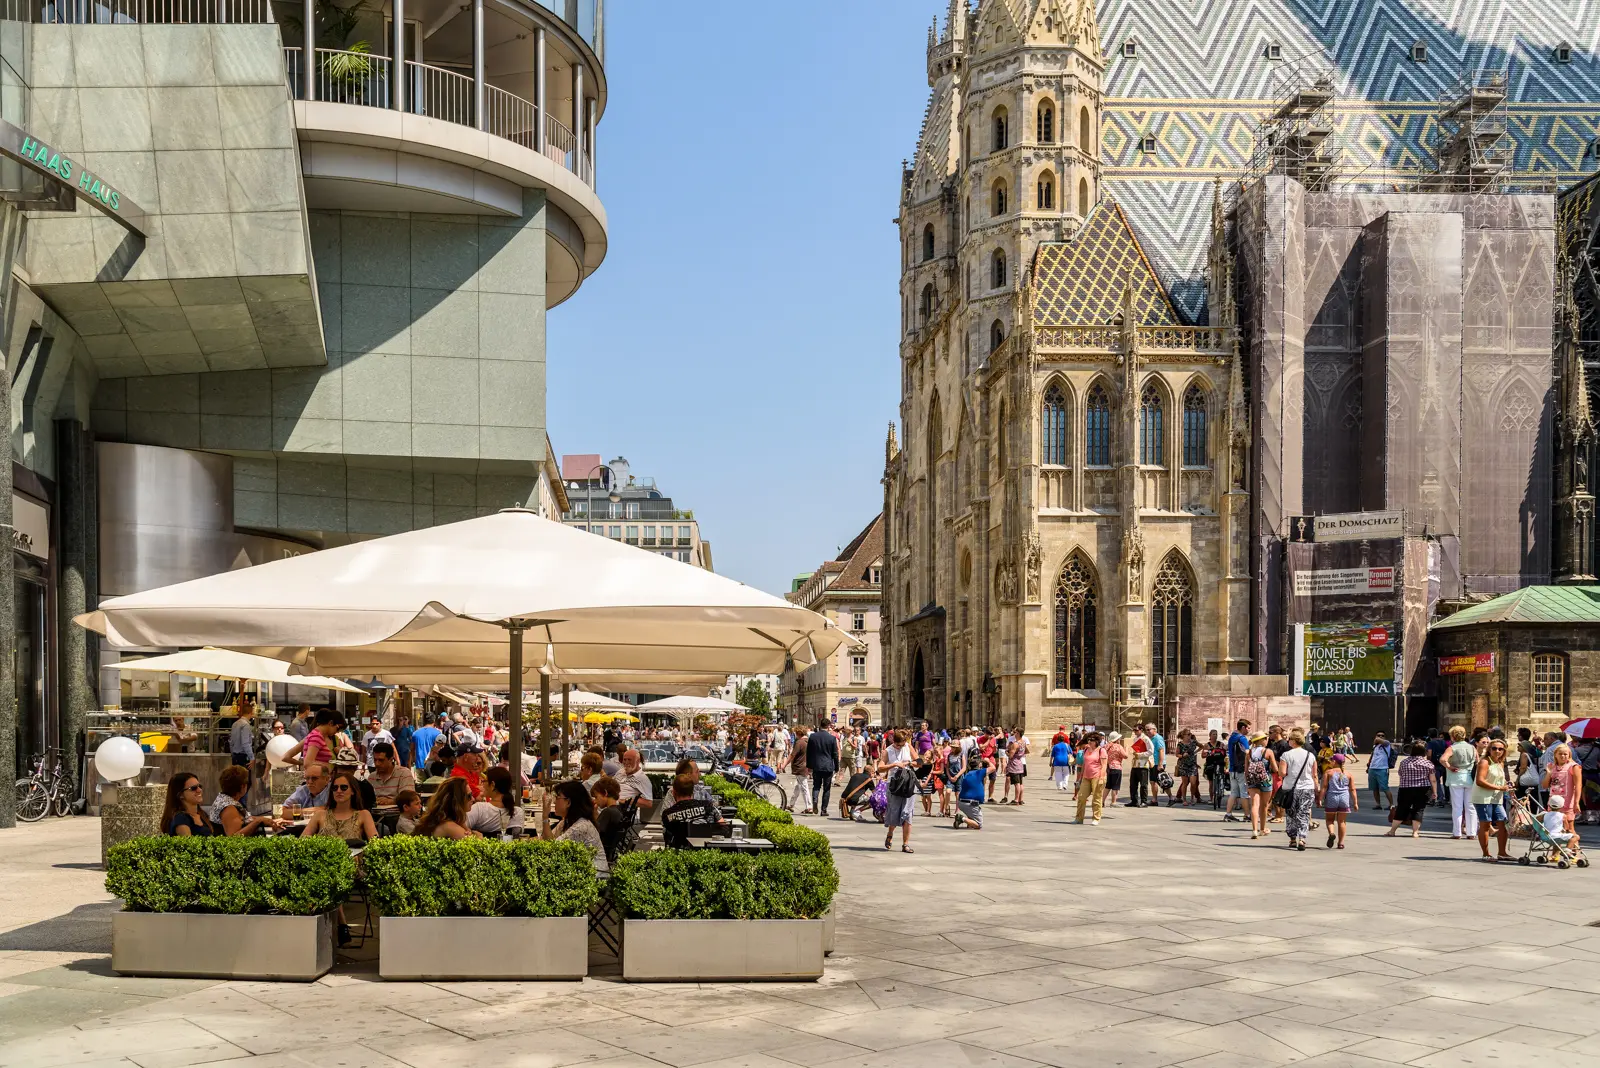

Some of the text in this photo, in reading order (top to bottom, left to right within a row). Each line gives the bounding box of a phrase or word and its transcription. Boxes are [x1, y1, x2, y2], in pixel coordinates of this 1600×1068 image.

[21, 136, 120, 210] HAAS HAUS
[1317, 517, 1399, 529] DER DOMSCHATZ
[1369, 570, 1392, 579] Kronen
[1368, 578, 1392, 587] Zeitung
[1306, 647, 1367, 659] MONET BIS
[1306, 658, 1355, 671] PICASSO
[1306, 681, 1389, 694] ALBERTINA
[667, 806, 706, 822] WESTSIDE
